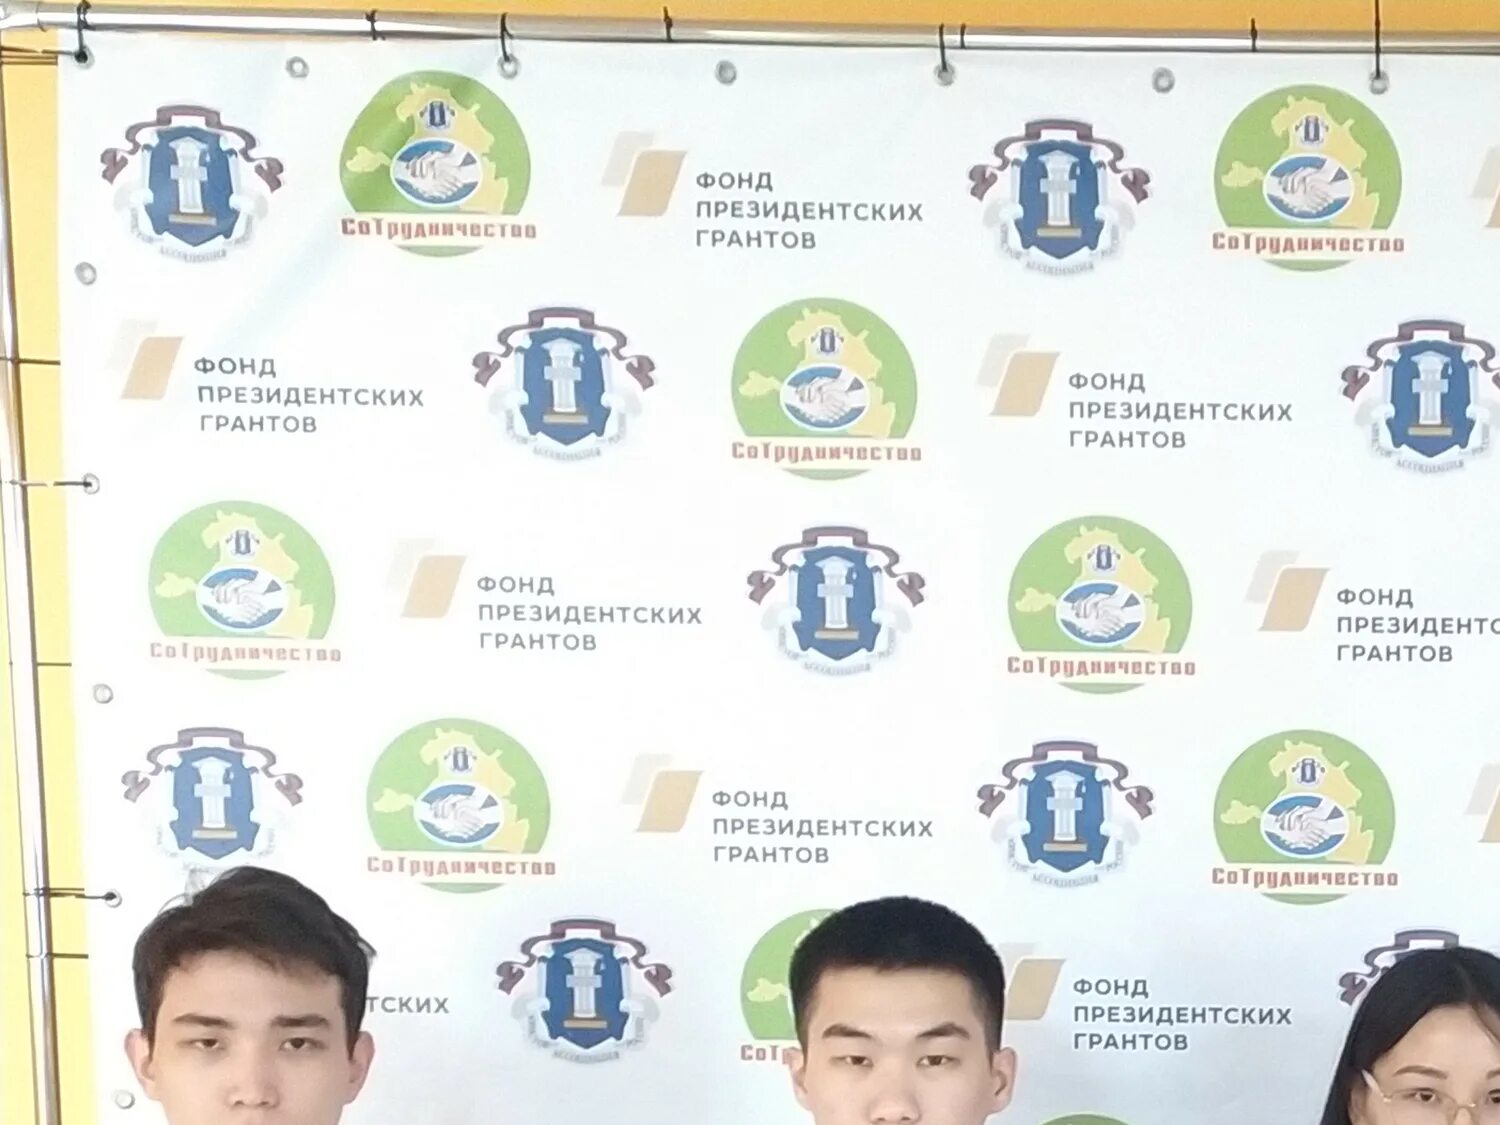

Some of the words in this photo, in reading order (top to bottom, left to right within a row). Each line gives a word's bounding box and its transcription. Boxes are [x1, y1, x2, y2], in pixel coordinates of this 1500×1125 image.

[696, 171, 774, 193] ФОНД
[696, 200, 923, 223] ПРЕЗИДЕНТСКИХ
[340, 217, 537, 240] СоТрудничество
[696, 229, 817, 250] ГРАНТОВ
[1212, 231, 1405, 254] СоТрудничество
[193, 356, 277, 379] ФОНД
[1068, 372, 1146, 395] ФОНД
[197, 385, 424, 408] ПРЕЗИДЕНТСКИХ
[1069, 401, 1293, 423] ПРЕЗИДЕНТСКИХ
[200, 414, 317, 433] ГРАНТОВ
[1069, 430, 1186, 449] ГРАНТОВ
[731, 441, 922, 464] СоТрудничество
[476, 575, 555, 597] ФОНД
[1336, 588, 1414, 610] ФОНД
[478, 604, 702, 626] ПРЕЗИДЕНТСКИХ
[479, 632, 597, 651] ГРАНТОВ
[1337, 644, 1453, 663] ГРАНТОВ
[1007, 656, 1196, 679] СоТрудничество
[712, 790, 789, 811] ФОНД
[713, 817, 933, 839] ПРЕЗИДЕНТСКИХ
[713, 845, 829, 864] ГРАНТОВ
[1211, 867, 1399, 890] СоТрудничество
[1073, 978, 1149, 999] ФОНД
[1074, 1005, 1292, 1027] ПРЕЗИДЕНТСКИХ
[1074, 1032, 1188, 1051] ГРАНТОВ
